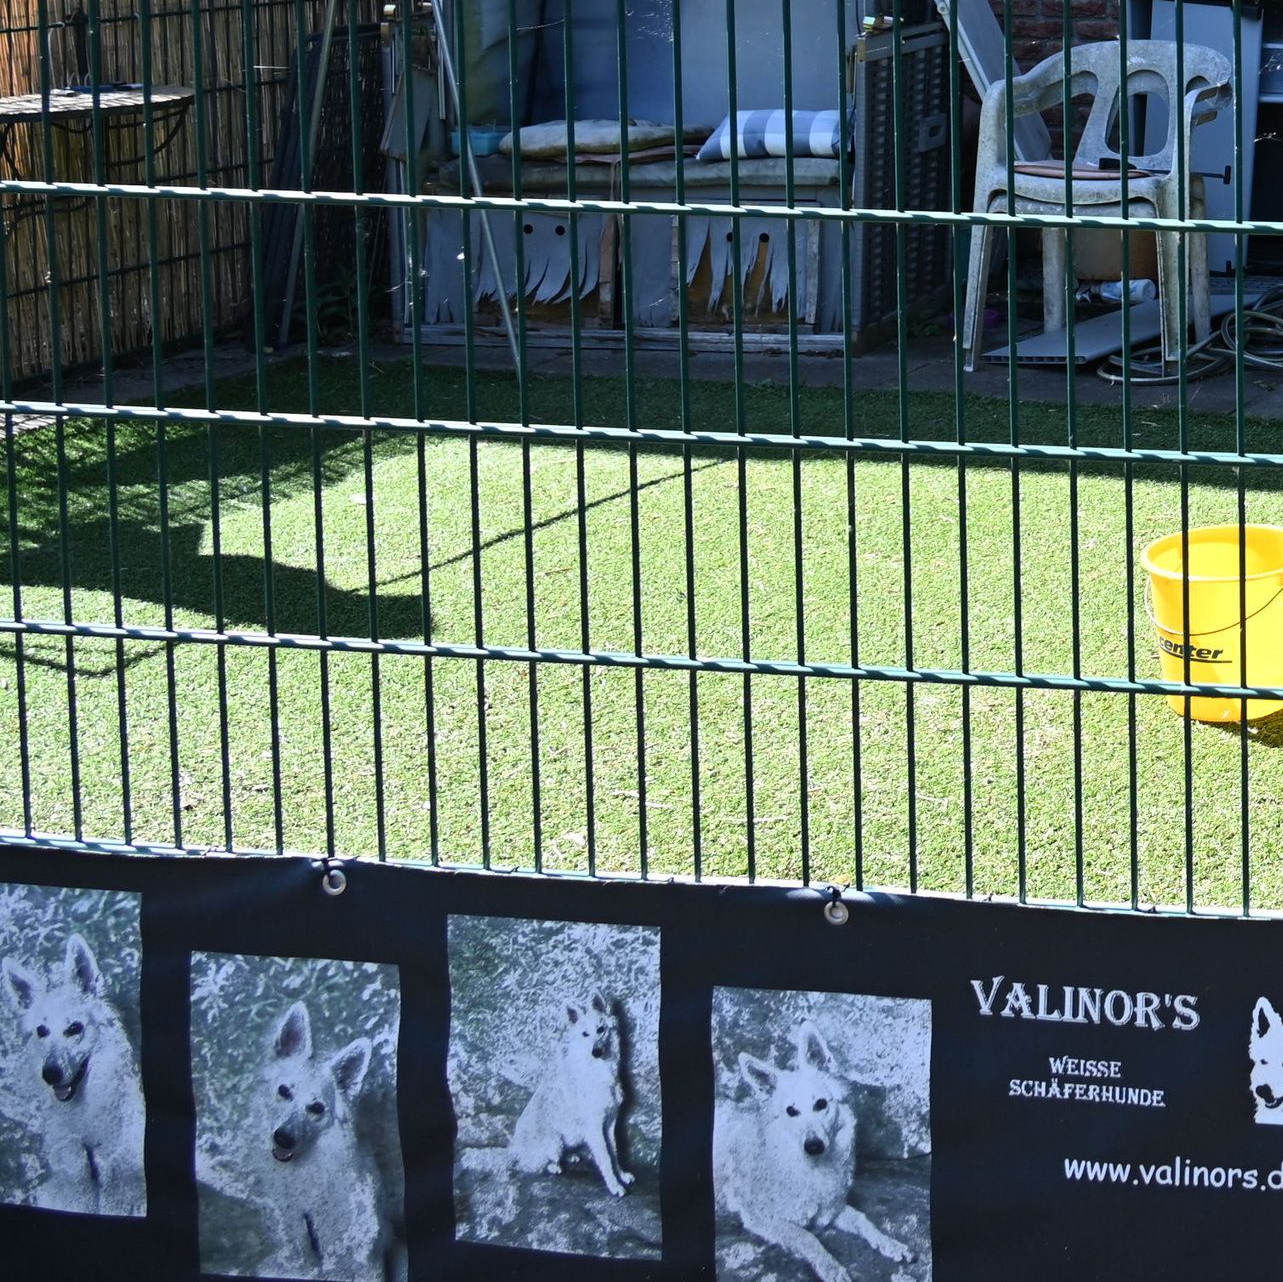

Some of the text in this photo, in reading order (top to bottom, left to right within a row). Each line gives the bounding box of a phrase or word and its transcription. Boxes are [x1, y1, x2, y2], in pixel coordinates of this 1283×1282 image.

[970, 976, 1200, 1030] VALINOR'S
[1049, 1056, 1122, 1080] WEISSE
[1008, 1079, 1166, 1107] SCHÄFERHUNDE
